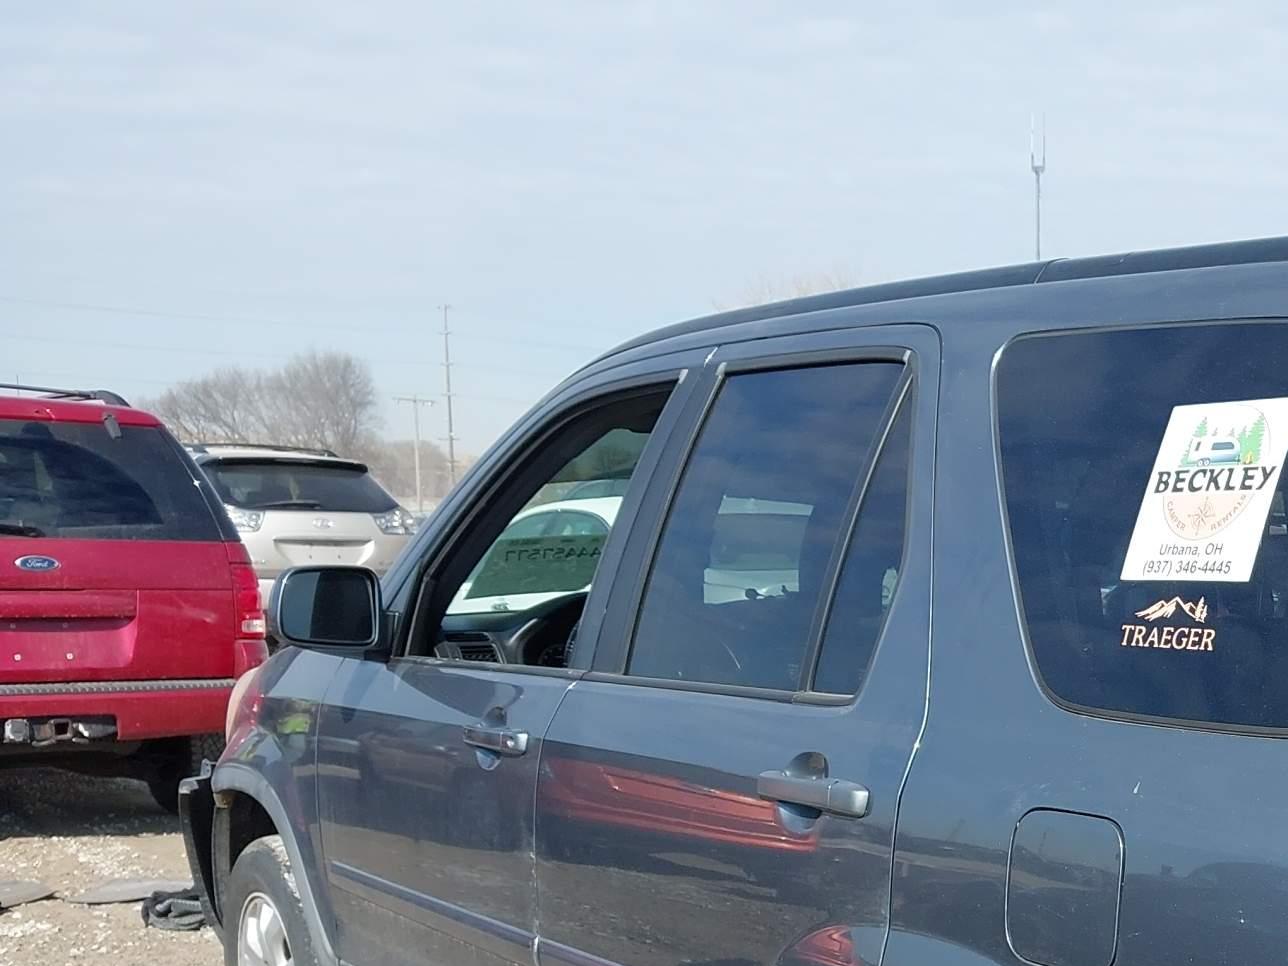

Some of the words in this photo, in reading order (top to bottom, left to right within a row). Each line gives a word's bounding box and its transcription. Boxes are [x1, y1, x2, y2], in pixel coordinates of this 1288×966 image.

[1154, 466, 1276, 494] BECKLEY
[1159, 543, 1201, 557] Urbana,
[1204, 543, 1224, 556] OH
[1143, 560, 1173, 576] (937)
[1175, 560, 1232, 575] 346-4445
[1120, 624, 1216, 651] TRAEGER
